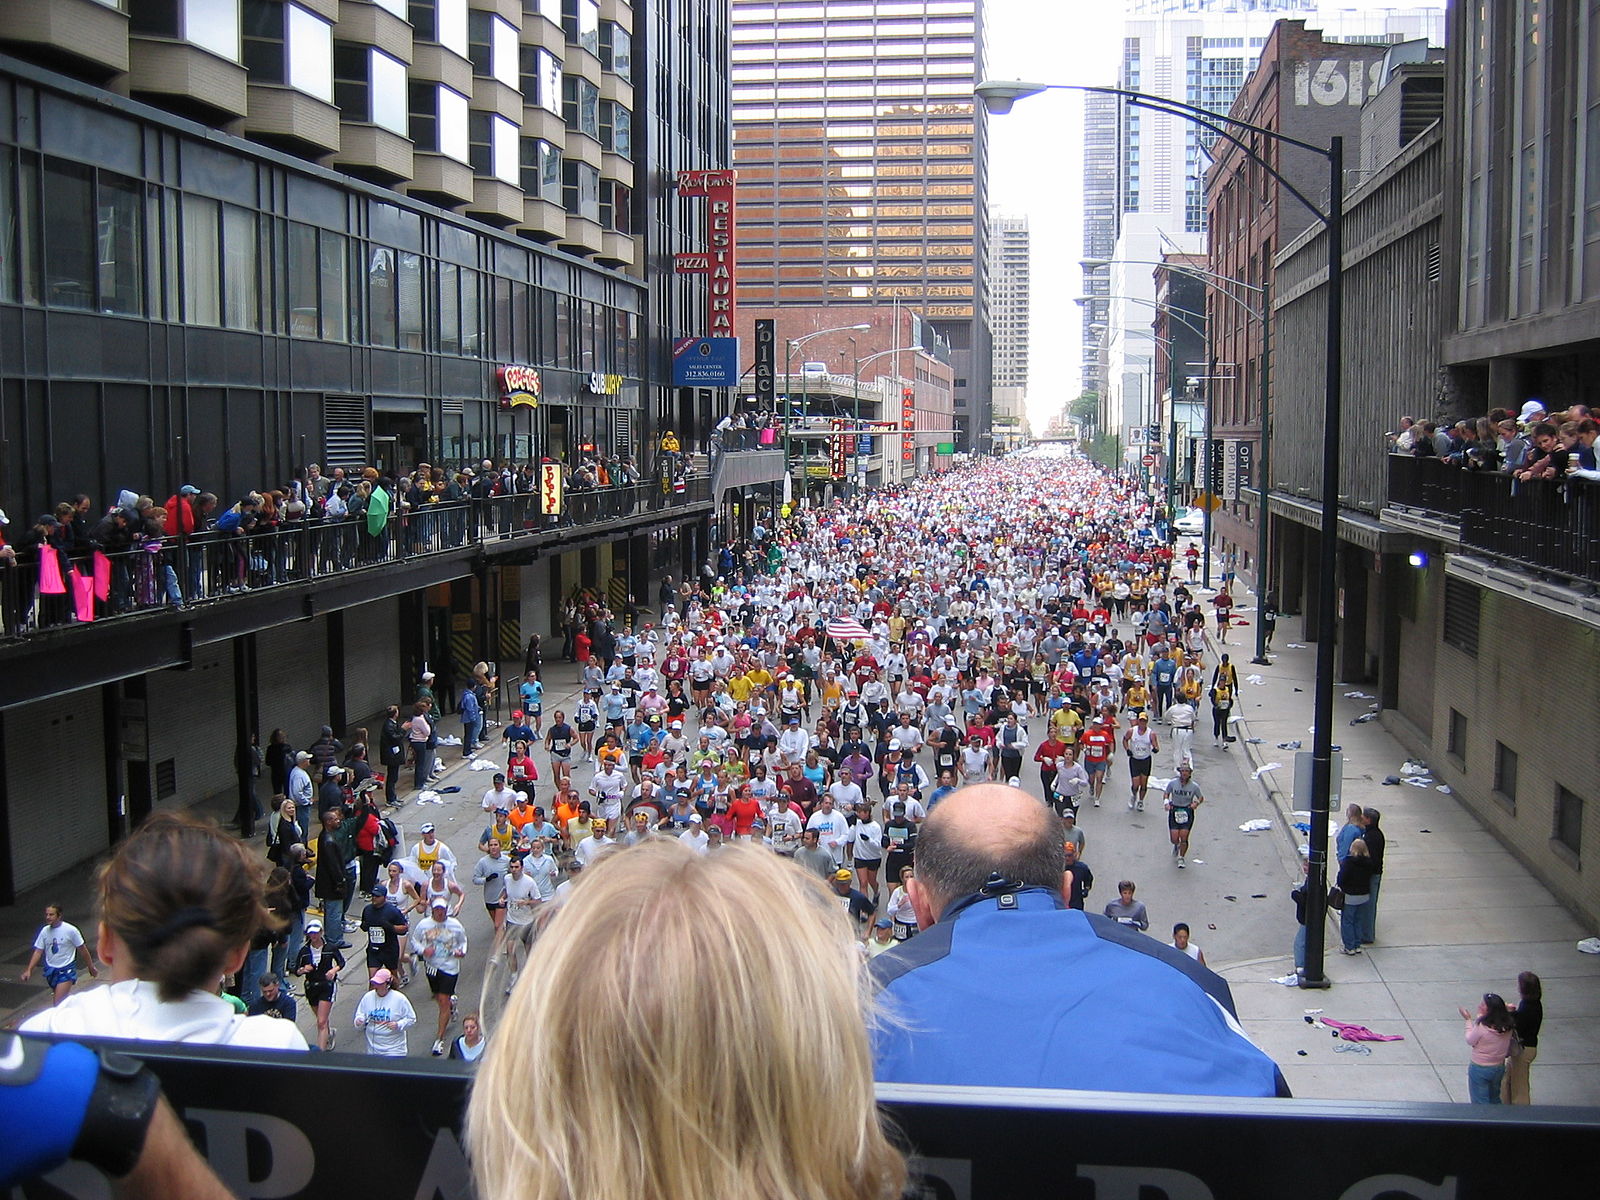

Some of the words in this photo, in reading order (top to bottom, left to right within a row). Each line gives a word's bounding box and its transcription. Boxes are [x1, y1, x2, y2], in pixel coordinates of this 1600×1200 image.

[676, 257, 709, 269] PIZZA
[713, 201, 730, 337] RESTAURAN
[590, 372, 623, 395] SUBWAY
[757, 330, 772, 411] black
[903, 388, 912, 459] PARKING
[1227, 446, 1236, 496] OPTIMUS
[1240, 446, 1249, 488] OPTIM
